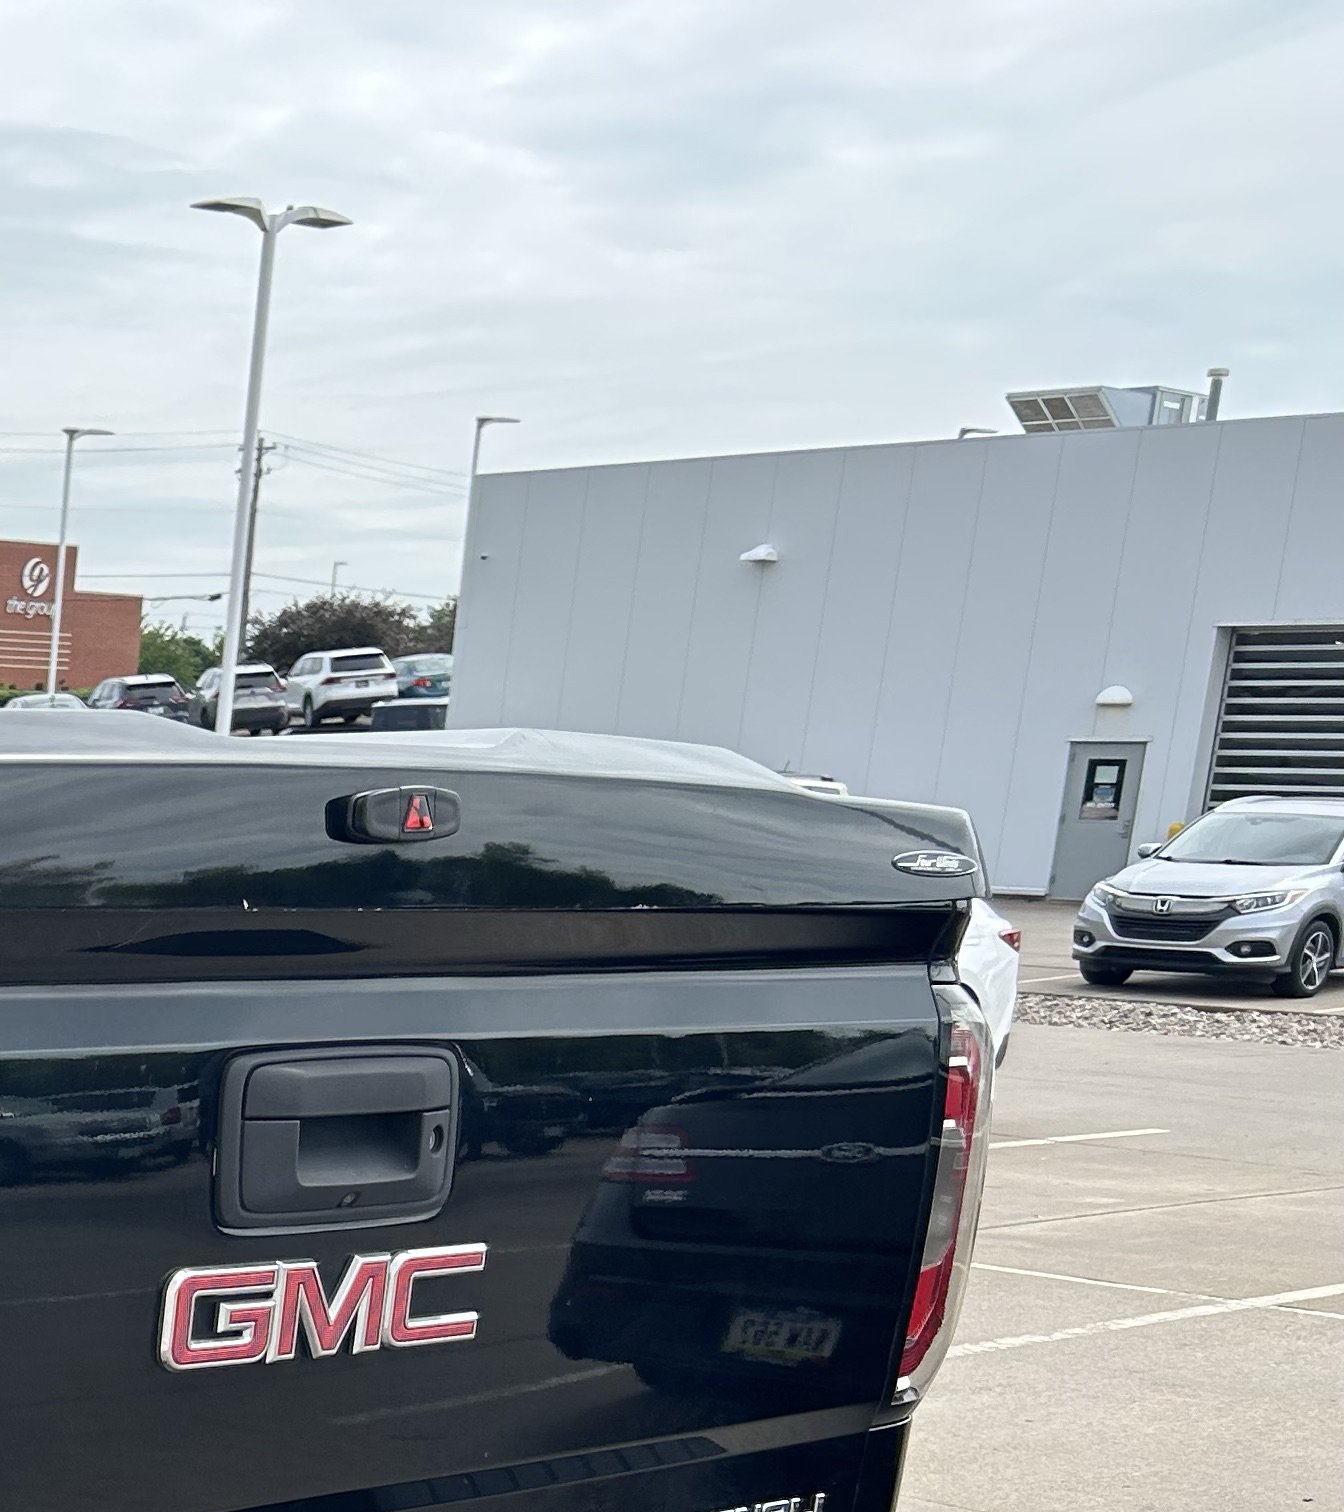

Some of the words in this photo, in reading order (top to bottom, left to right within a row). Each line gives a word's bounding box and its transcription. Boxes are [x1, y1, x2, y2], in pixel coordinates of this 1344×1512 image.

[6, 596, 26, 614] the
[25, 601, 55, 619] grou
[159, 1242, 488, 1372] GMC
